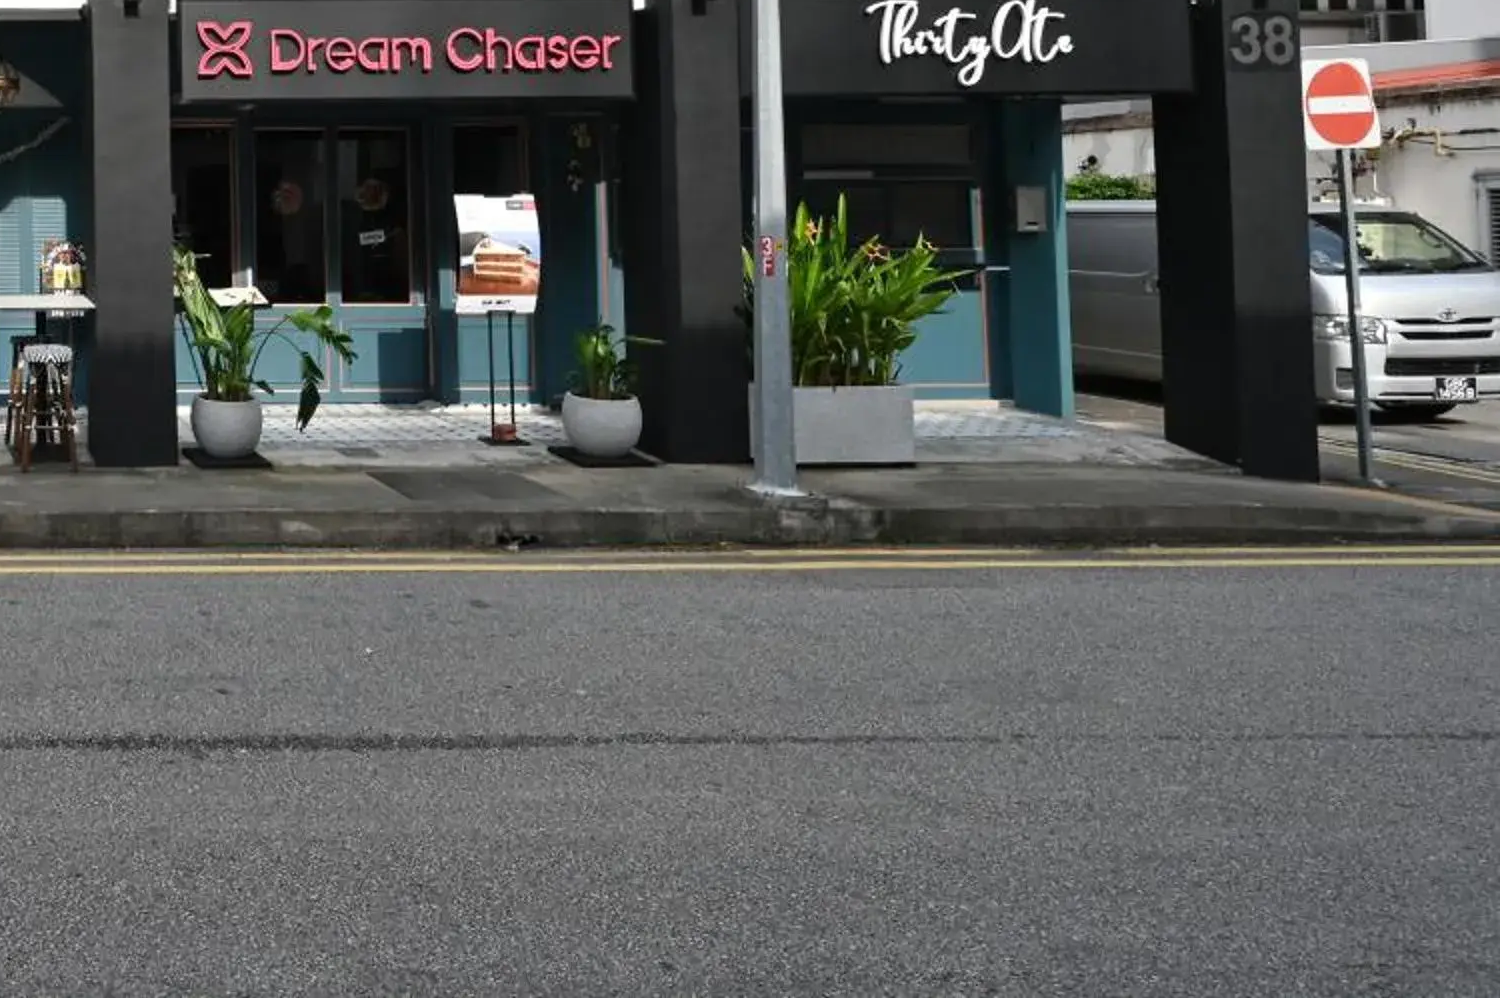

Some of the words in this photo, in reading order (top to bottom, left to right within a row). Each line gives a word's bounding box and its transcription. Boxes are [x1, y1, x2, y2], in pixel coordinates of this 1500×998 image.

[270, 28, 433, 73] Dream
[445, 25, 622, 73] Chaser
[1229, 15, 1295, 66] 38
